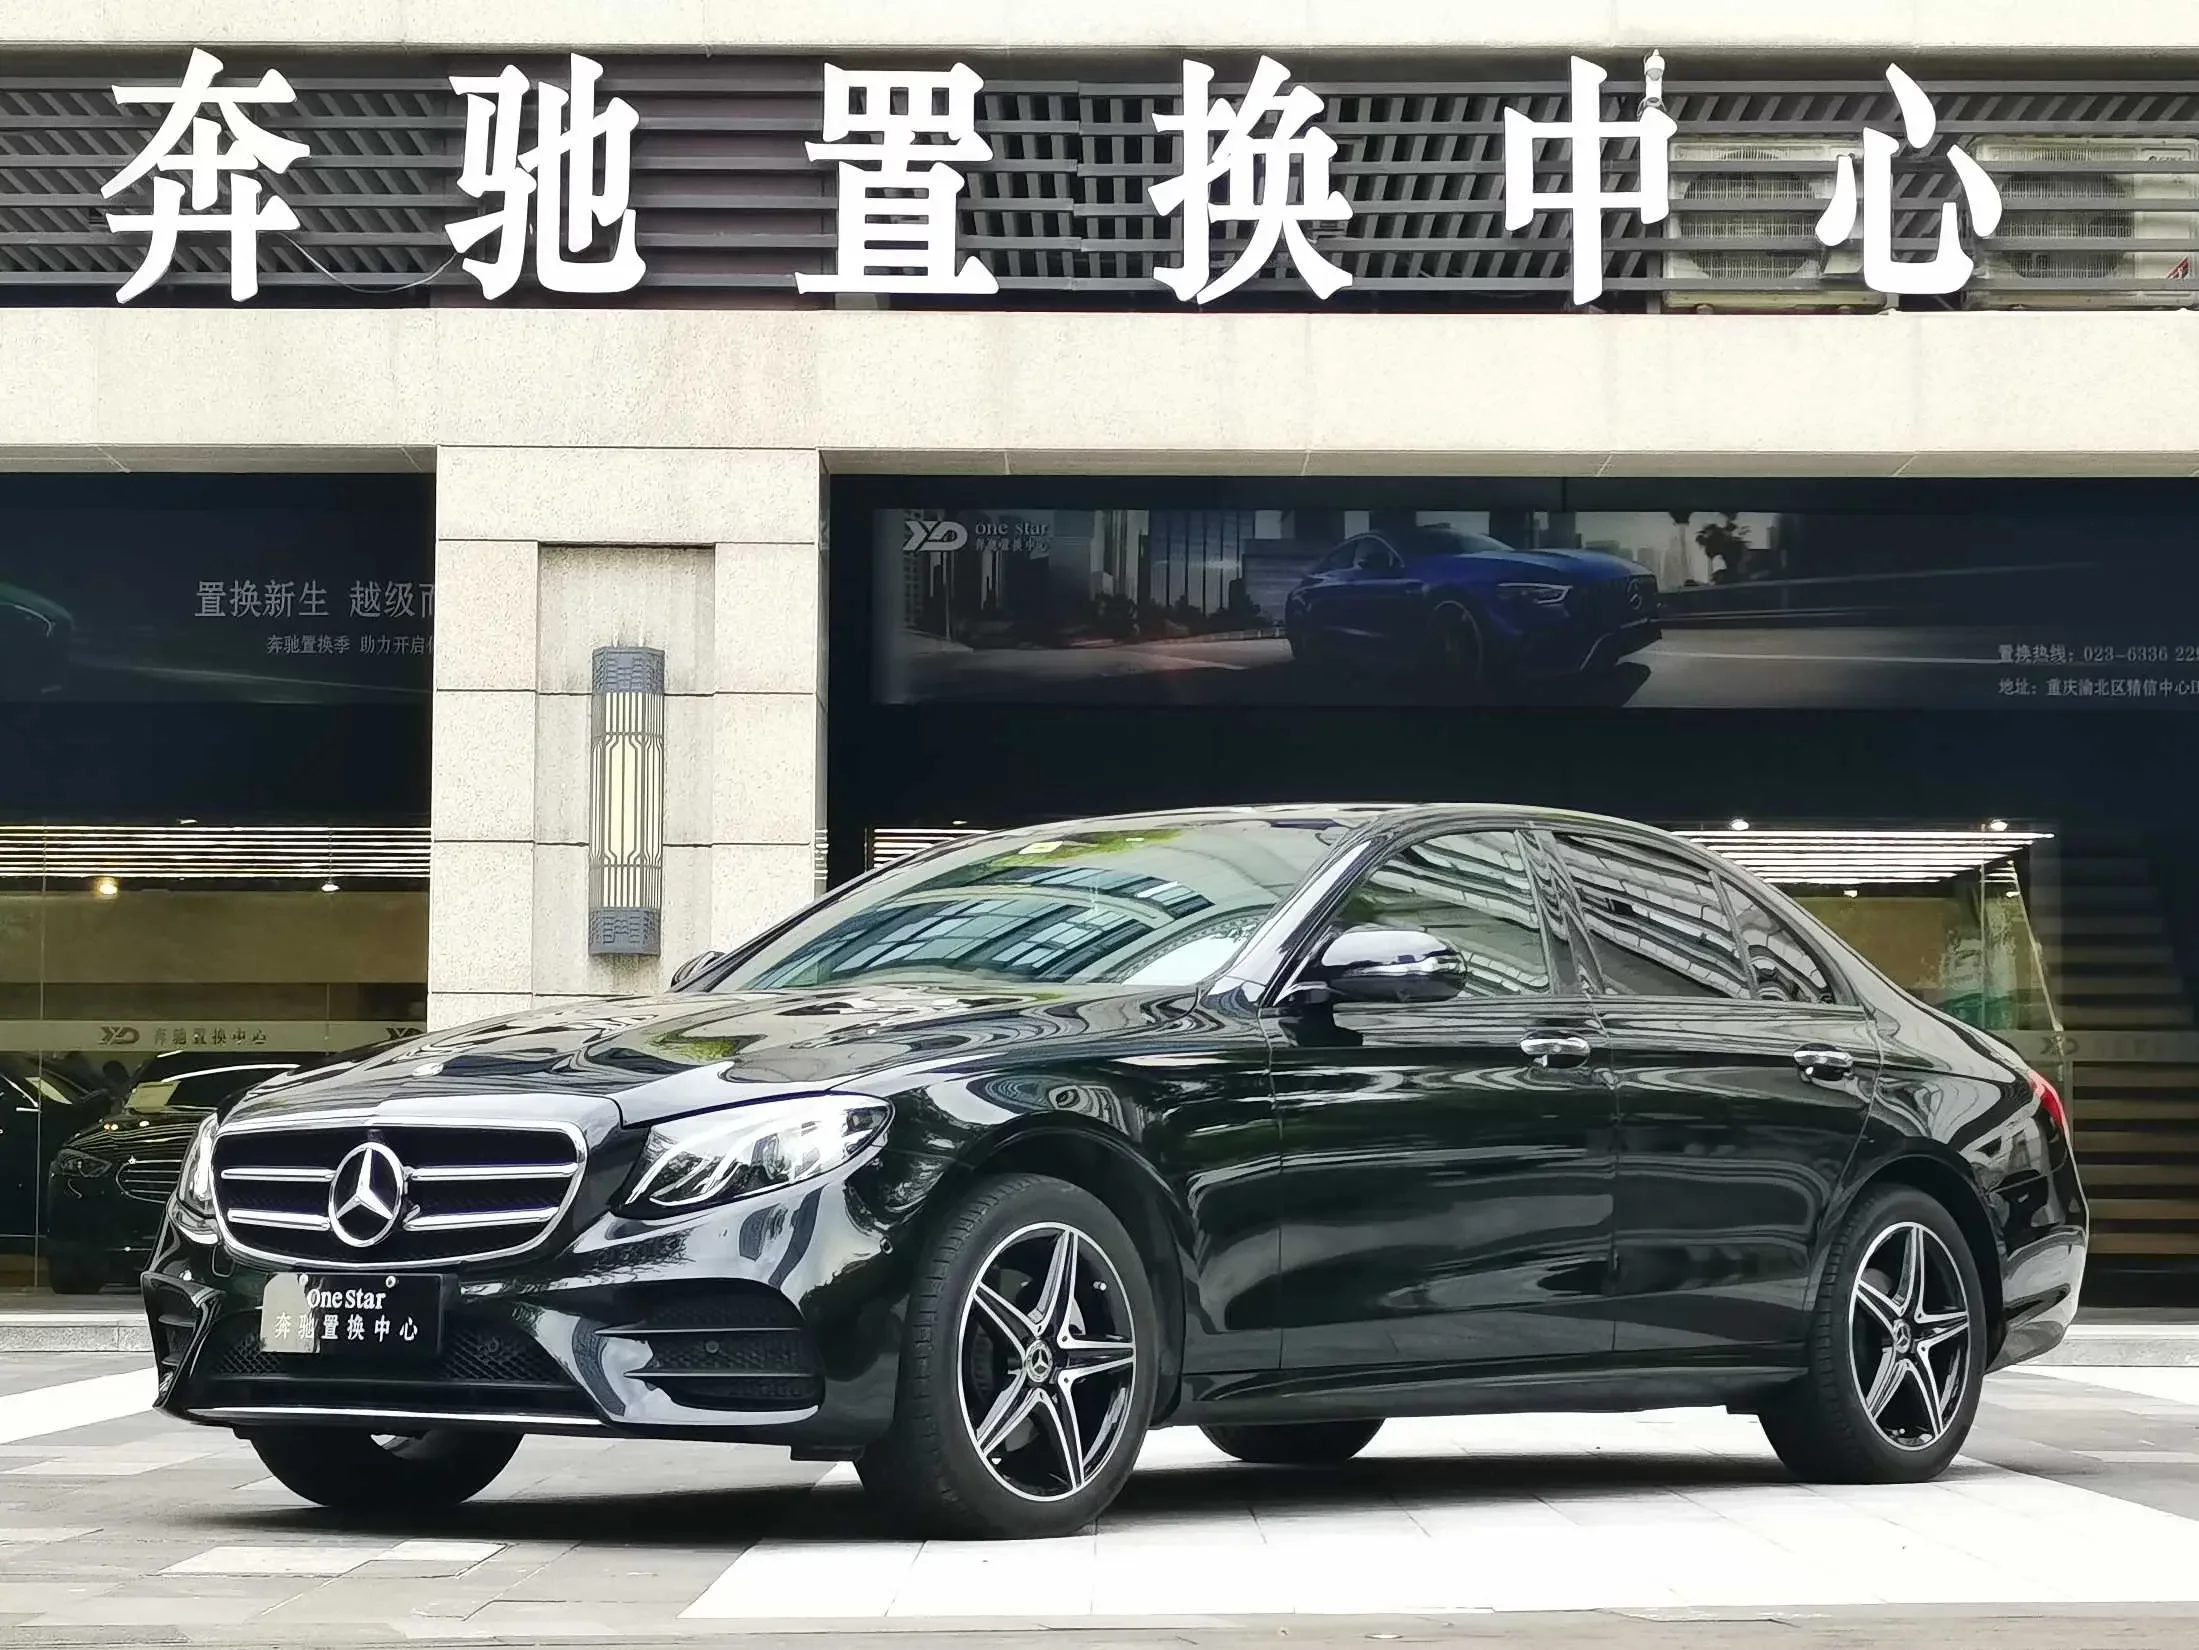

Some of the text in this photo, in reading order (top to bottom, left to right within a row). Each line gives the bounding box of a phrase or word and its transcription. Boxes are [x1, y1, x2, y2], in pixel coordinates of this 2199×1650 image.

[100, 47, 2002, 306] 奔驰置换中心
[194, 579, 330, 618] 置换新生
[266, 634, 351, 656] 奔驰置换季
[2175, 645, 2199, 662] 22
[274, 1311, 418, 1343] 奔驰置换中心
